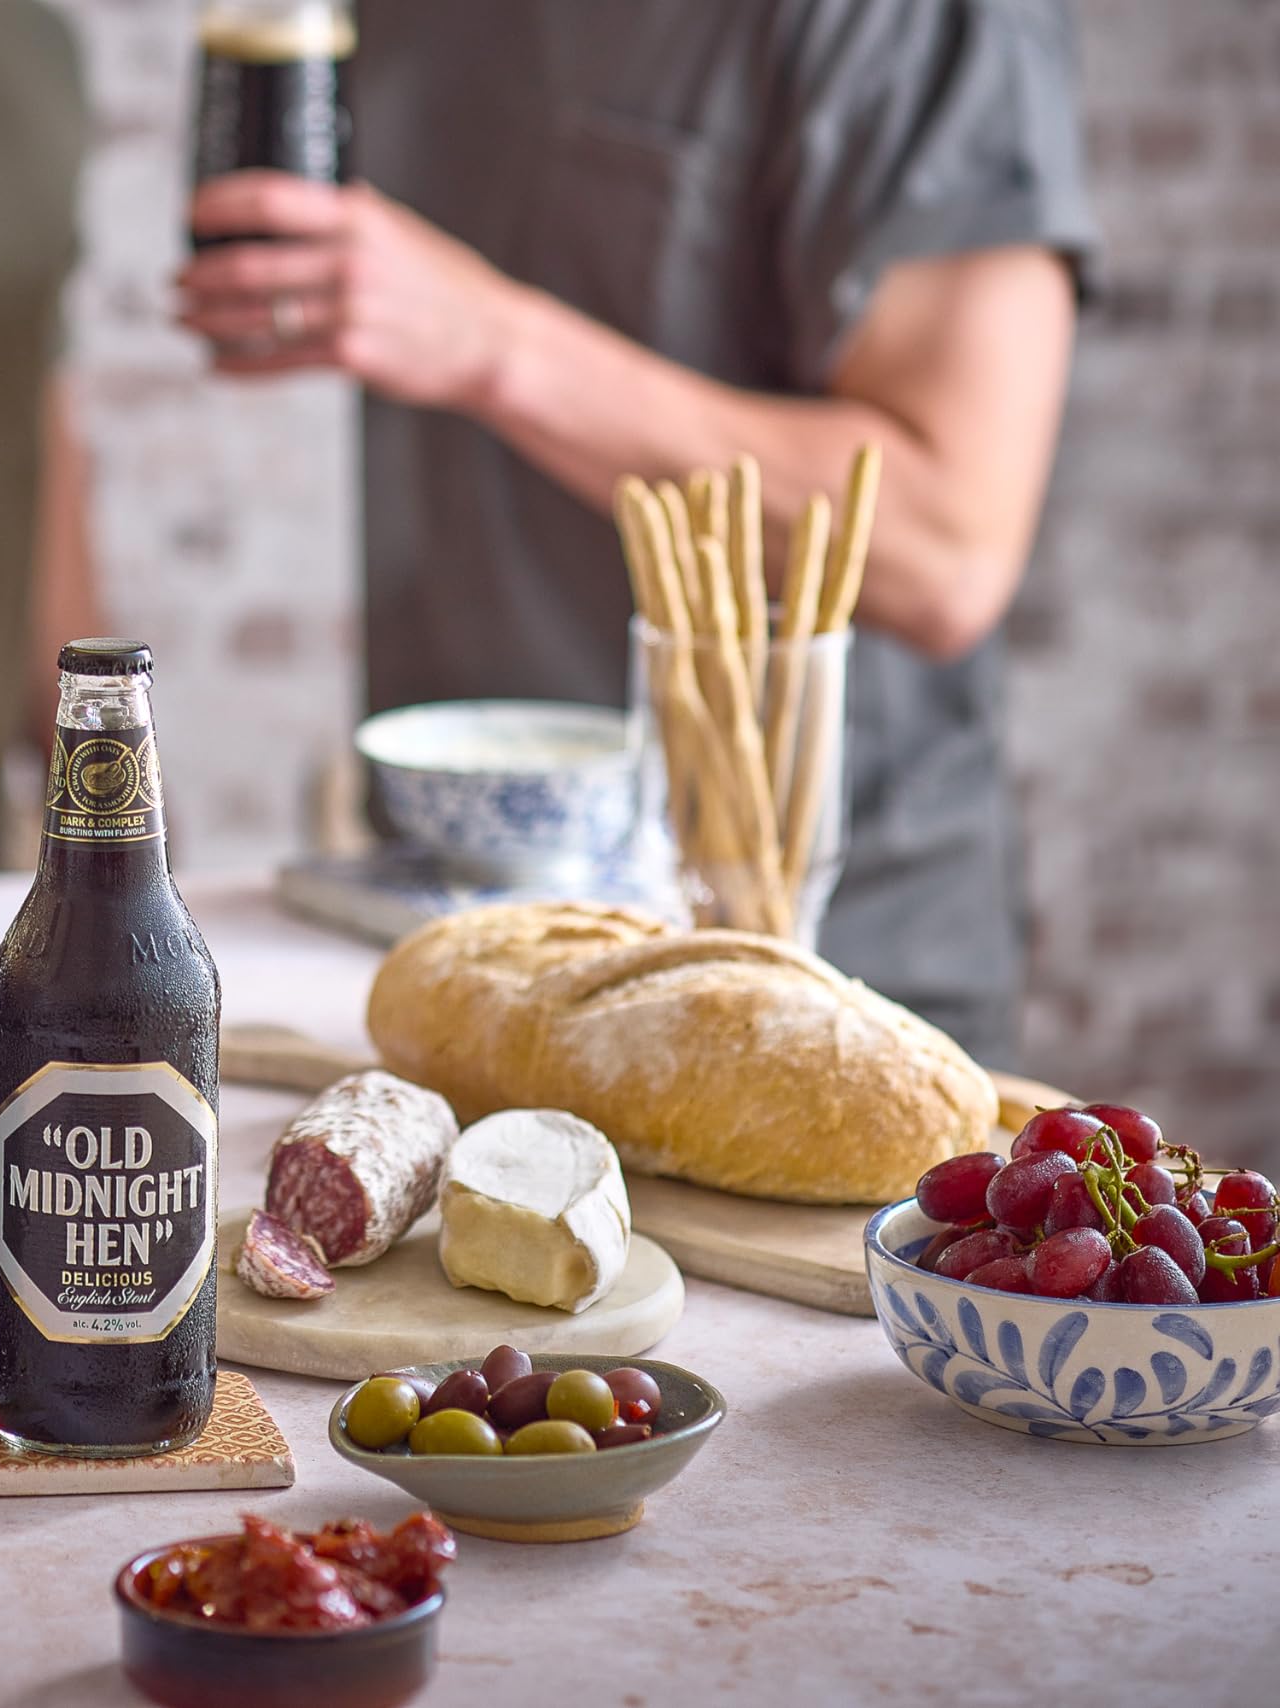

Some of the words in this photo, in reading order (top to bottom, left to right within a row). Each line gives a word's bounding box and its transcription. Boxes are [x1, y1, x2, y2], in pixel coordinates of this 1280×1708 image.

[59, 826, 93, 836] BURSTING
[94, 829, 114, 837] WITH
[114, 826, 147, 836] FLAVOUR
[60, 815, 86, 828] DARK
[87, 818, 95, 828] &
[97, 815, 146, 828] COMPLEX
[42, 1124, 153, 1170] “OLD
[9, 1164, 203, 1218] MIDNIGHT
[65, 1219, 173, 1267] HEN”
[62, 1271, 153, 1287] DELICIOUS
[57, 1286, 112, 1311] English
[111, 1287, 156, 1306] Stout
[73, 1320, 89, 1329] alc.
[91, 1319, 124, 1332] 4.2%
[126, 1320, 142, 1329] vol.
